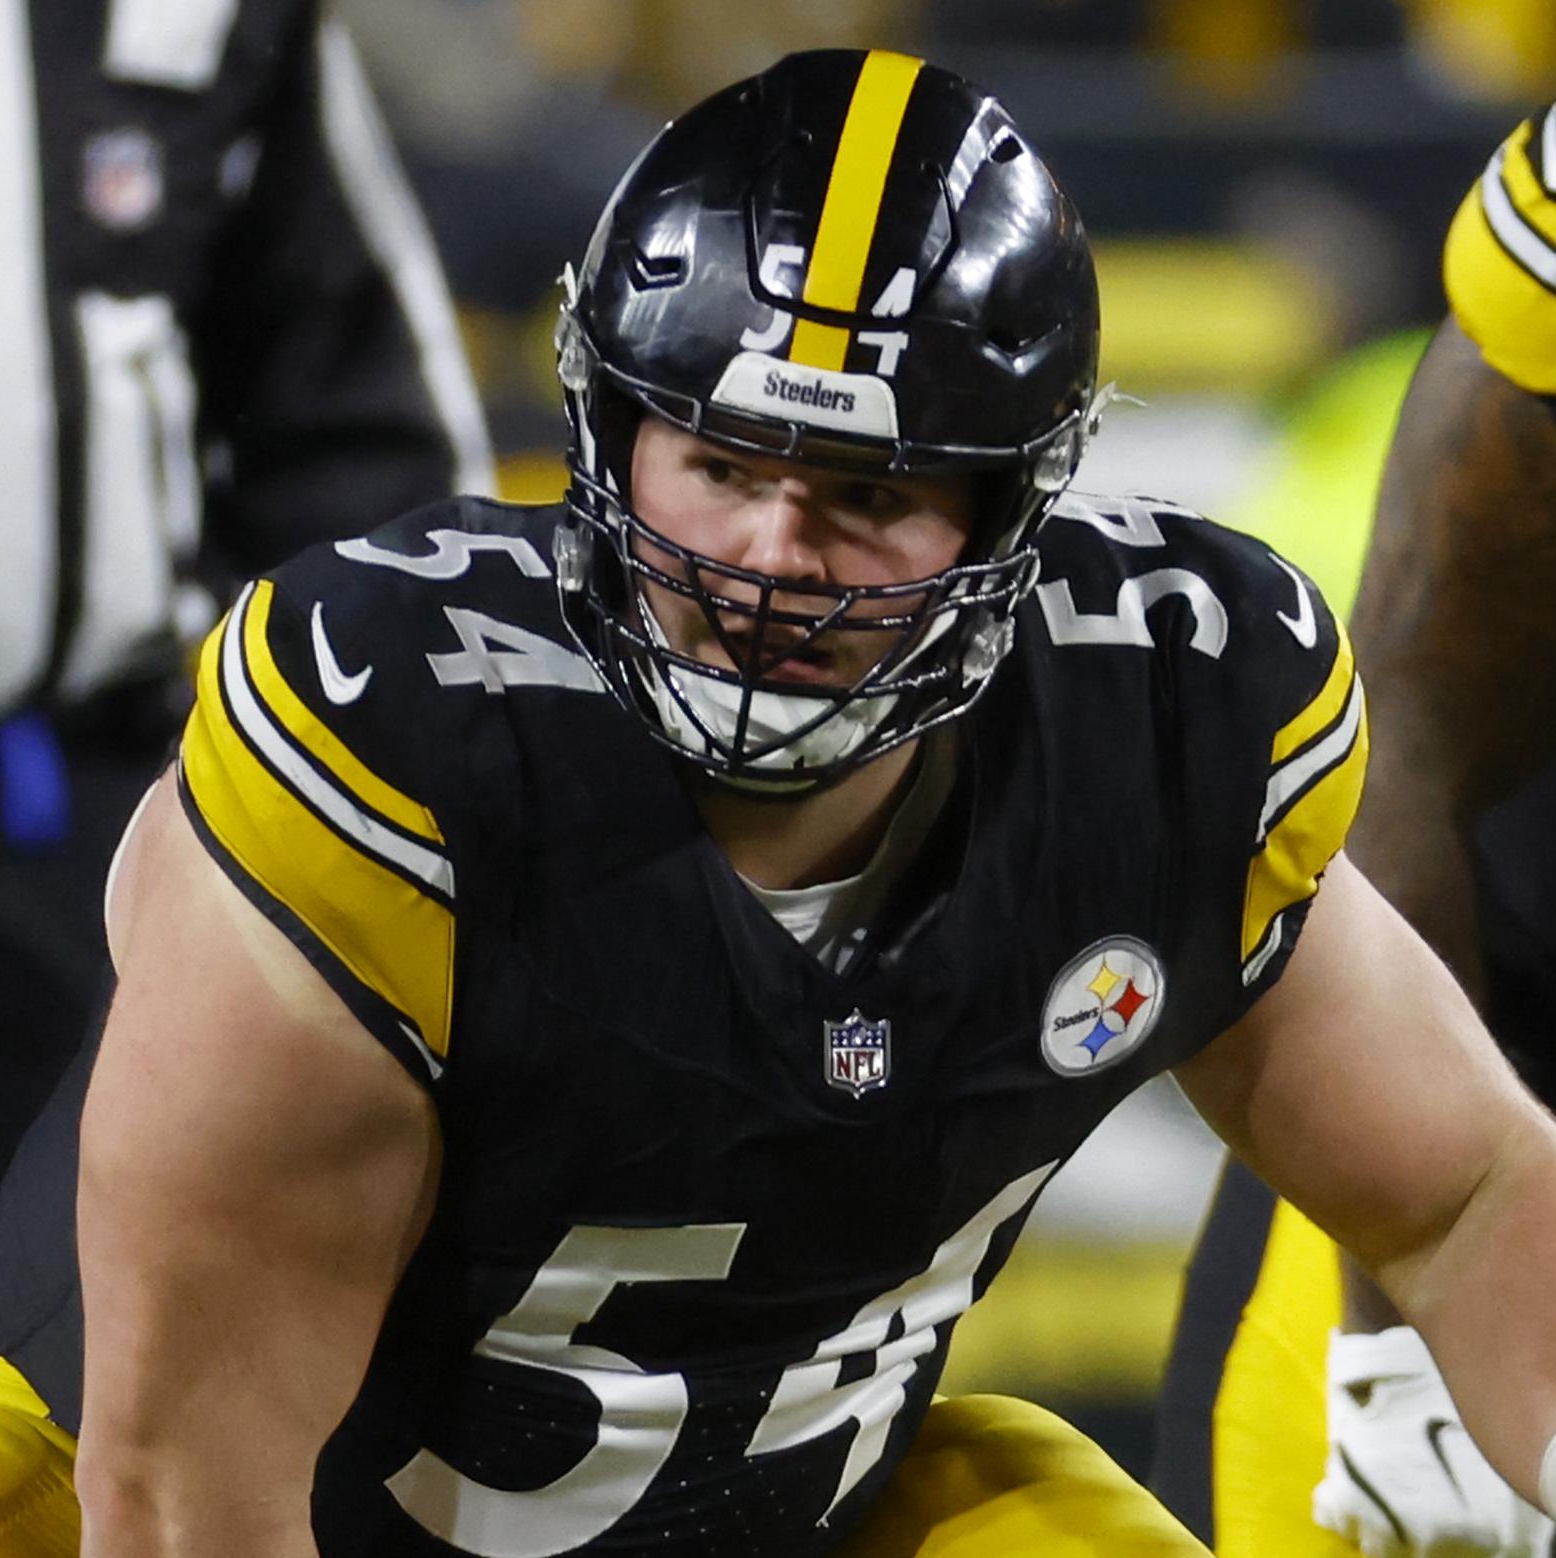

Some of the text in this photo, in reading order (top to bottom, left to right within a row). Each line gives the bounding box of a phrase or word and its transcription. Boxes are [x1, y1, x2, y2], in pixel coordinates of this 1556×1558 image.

[740, 243, 917, 377] 54
[763, 368, 856, 412] Steelers
[334, 528, 607, 694] 54
[1053, 1006, 1100, 1033] Steelers
[834, 1050, 882, 1082] NFL
